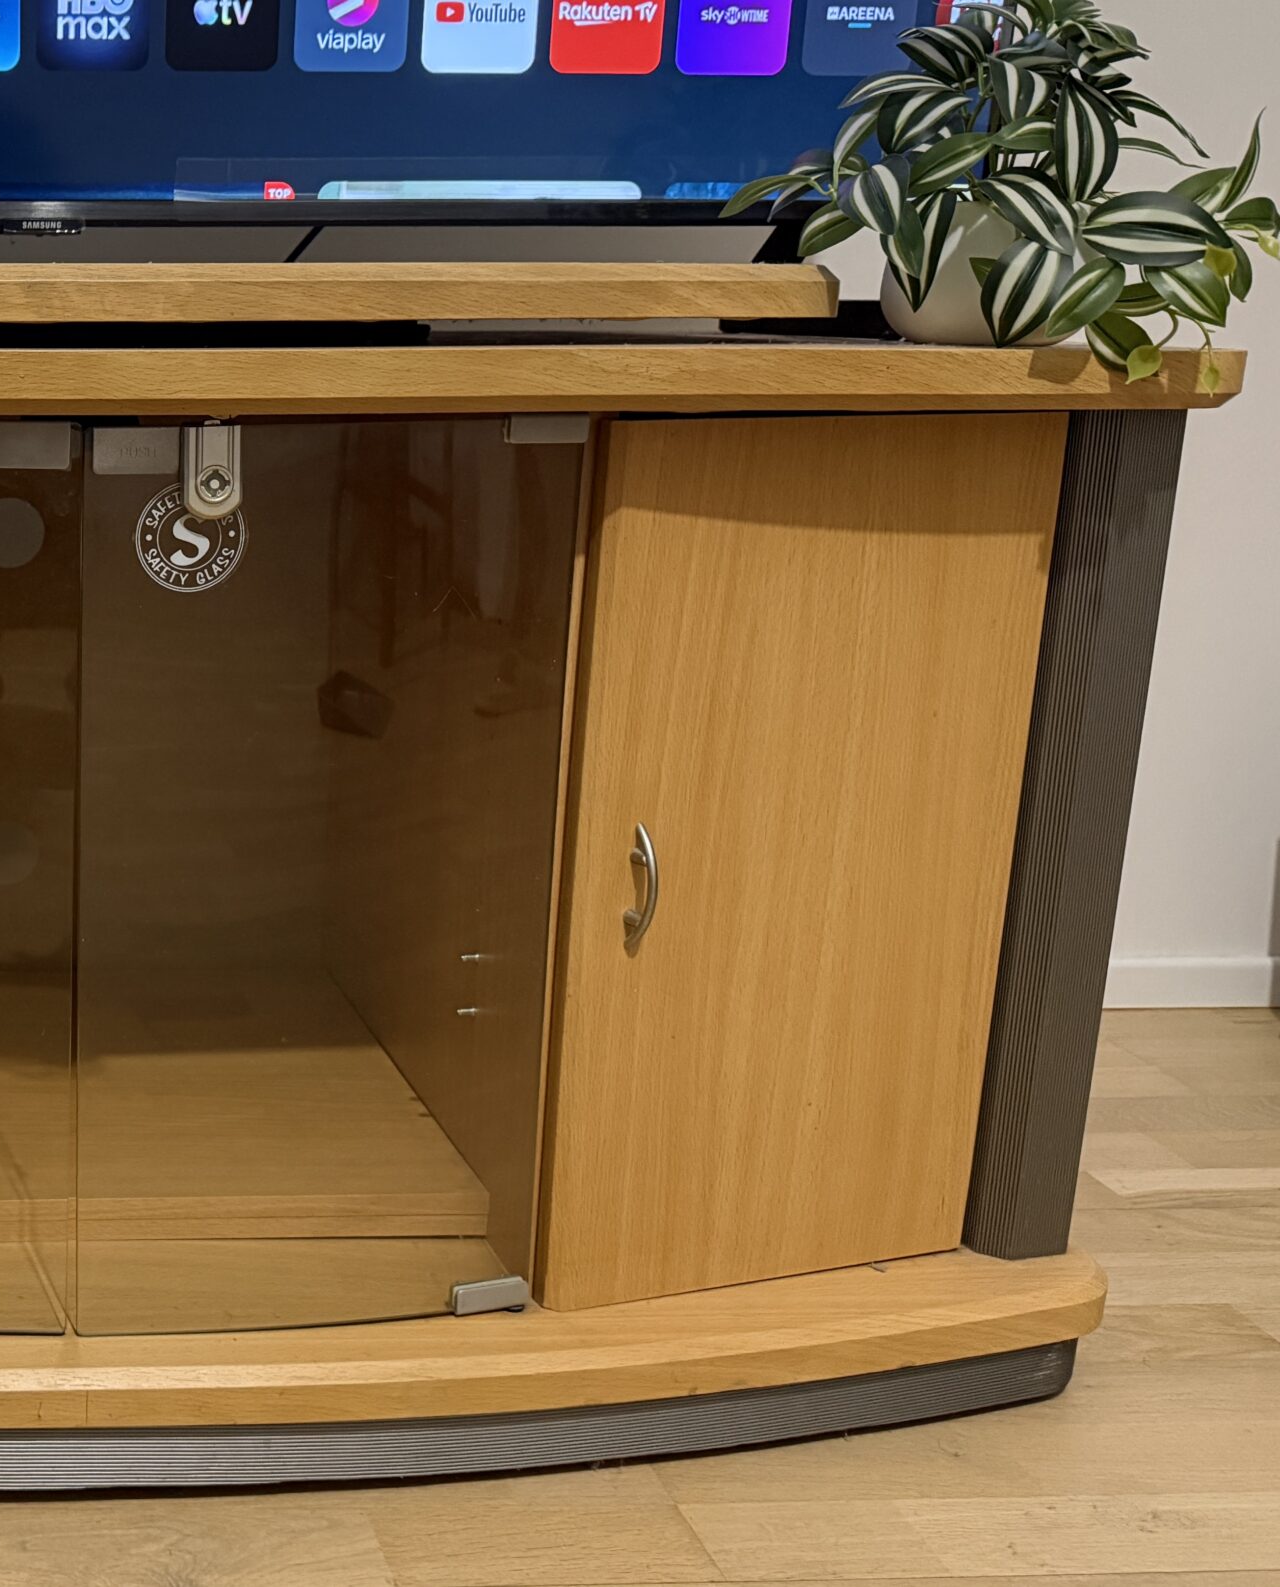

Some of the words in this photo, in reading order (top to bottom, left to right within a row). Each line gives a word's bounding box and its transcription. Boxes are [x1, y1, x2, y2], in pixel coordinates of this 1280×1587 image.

[469, 3, 526, 23] YouTube
[558, 2, 632, 21] Rakuten
[634, 2, 658, 23] TV
[838, 6, 895, 21] AREENA
[56, 16, 131, 40] max
[316, 29, 386, 53] viaplay
[268, 188, 292, 200] TOP
[22, 221, 62, 229] SAMSUNG
[145, 492, 181, 529] SAFET
[144, 548, 189, 585] SAFETY
[196, 547, 235, 585] GLASS
